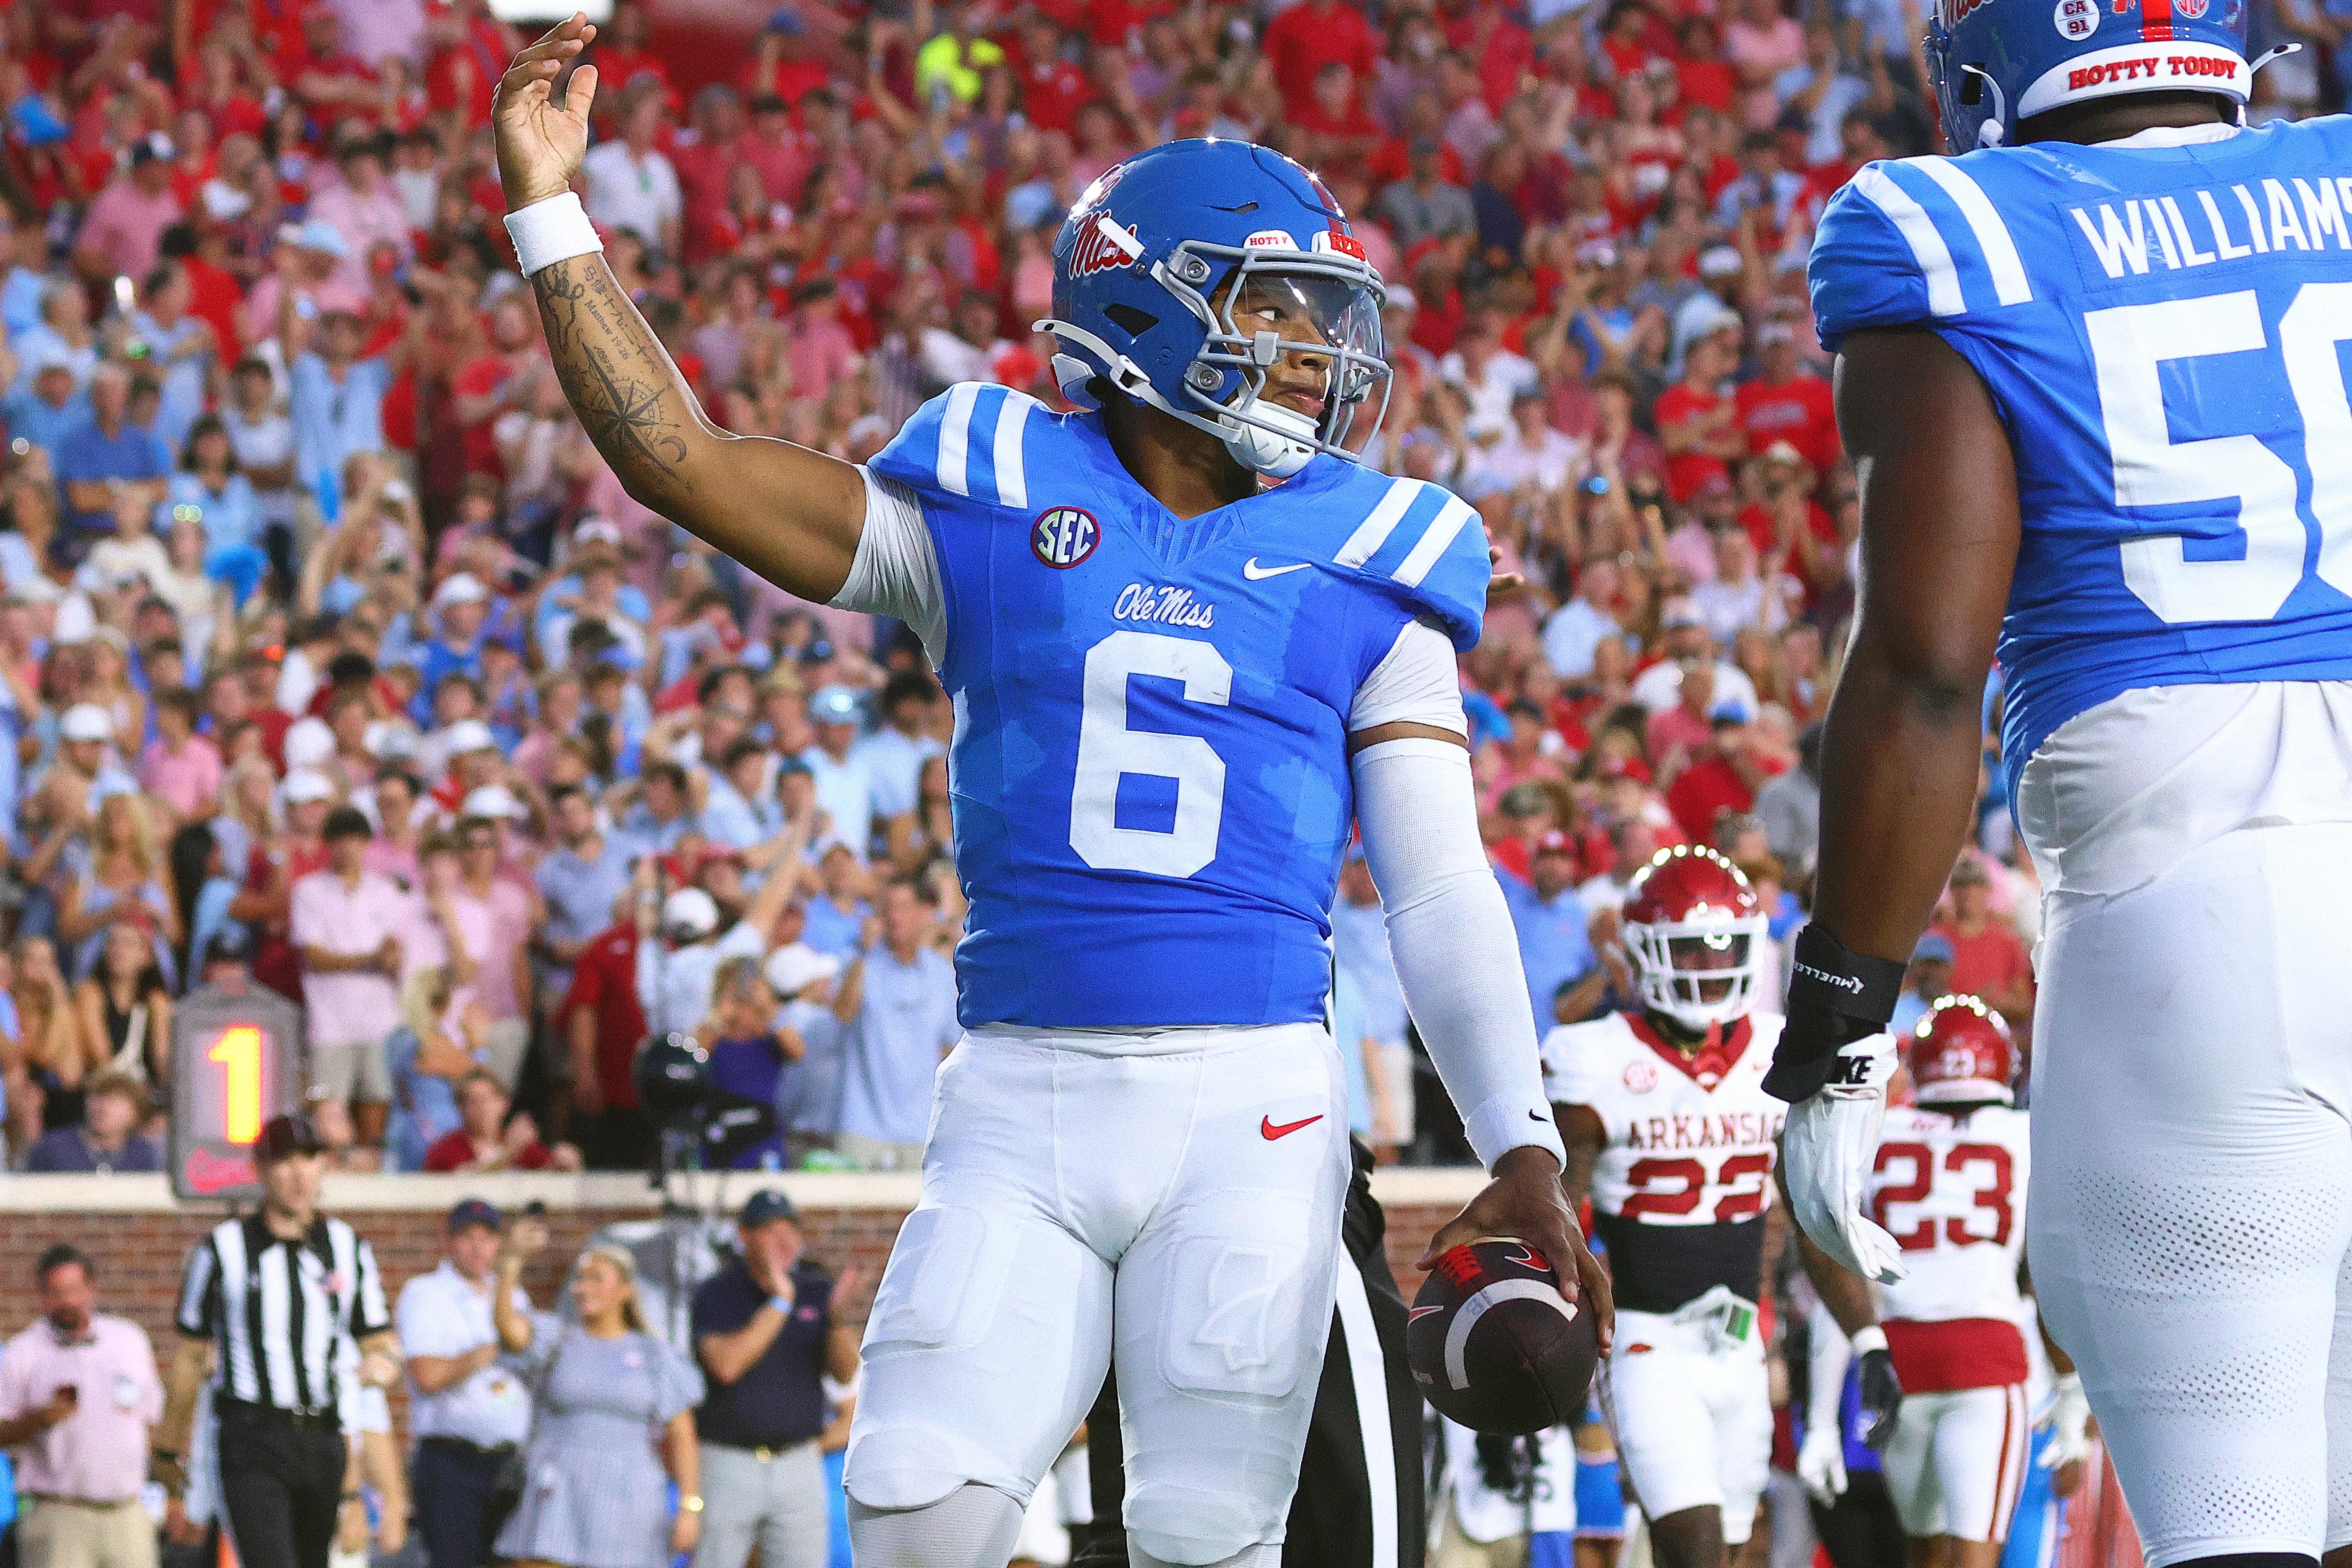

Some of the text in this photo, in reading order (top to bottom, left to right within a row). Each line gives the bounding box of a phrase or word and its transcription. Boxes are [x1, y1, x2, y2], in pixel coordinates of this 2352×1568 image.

[2064, 0, 2089, 16] CA
[2067, 19, 2090, 35] 91
[2069, 56, 2238, 90] HOTTY TODDY
[1037, 510, 1095, 564] SEC
[1113, 582, 1215, 629] Ole Miss
[1068, 629, 1234, 879] 6
[1794, 961, 1854, 989] MUELLE
[207, 1023, 262, 1145] 1
[1620, 1152, 1769, 1222] 22
[1873, 1143, 2013, 1251] 23
